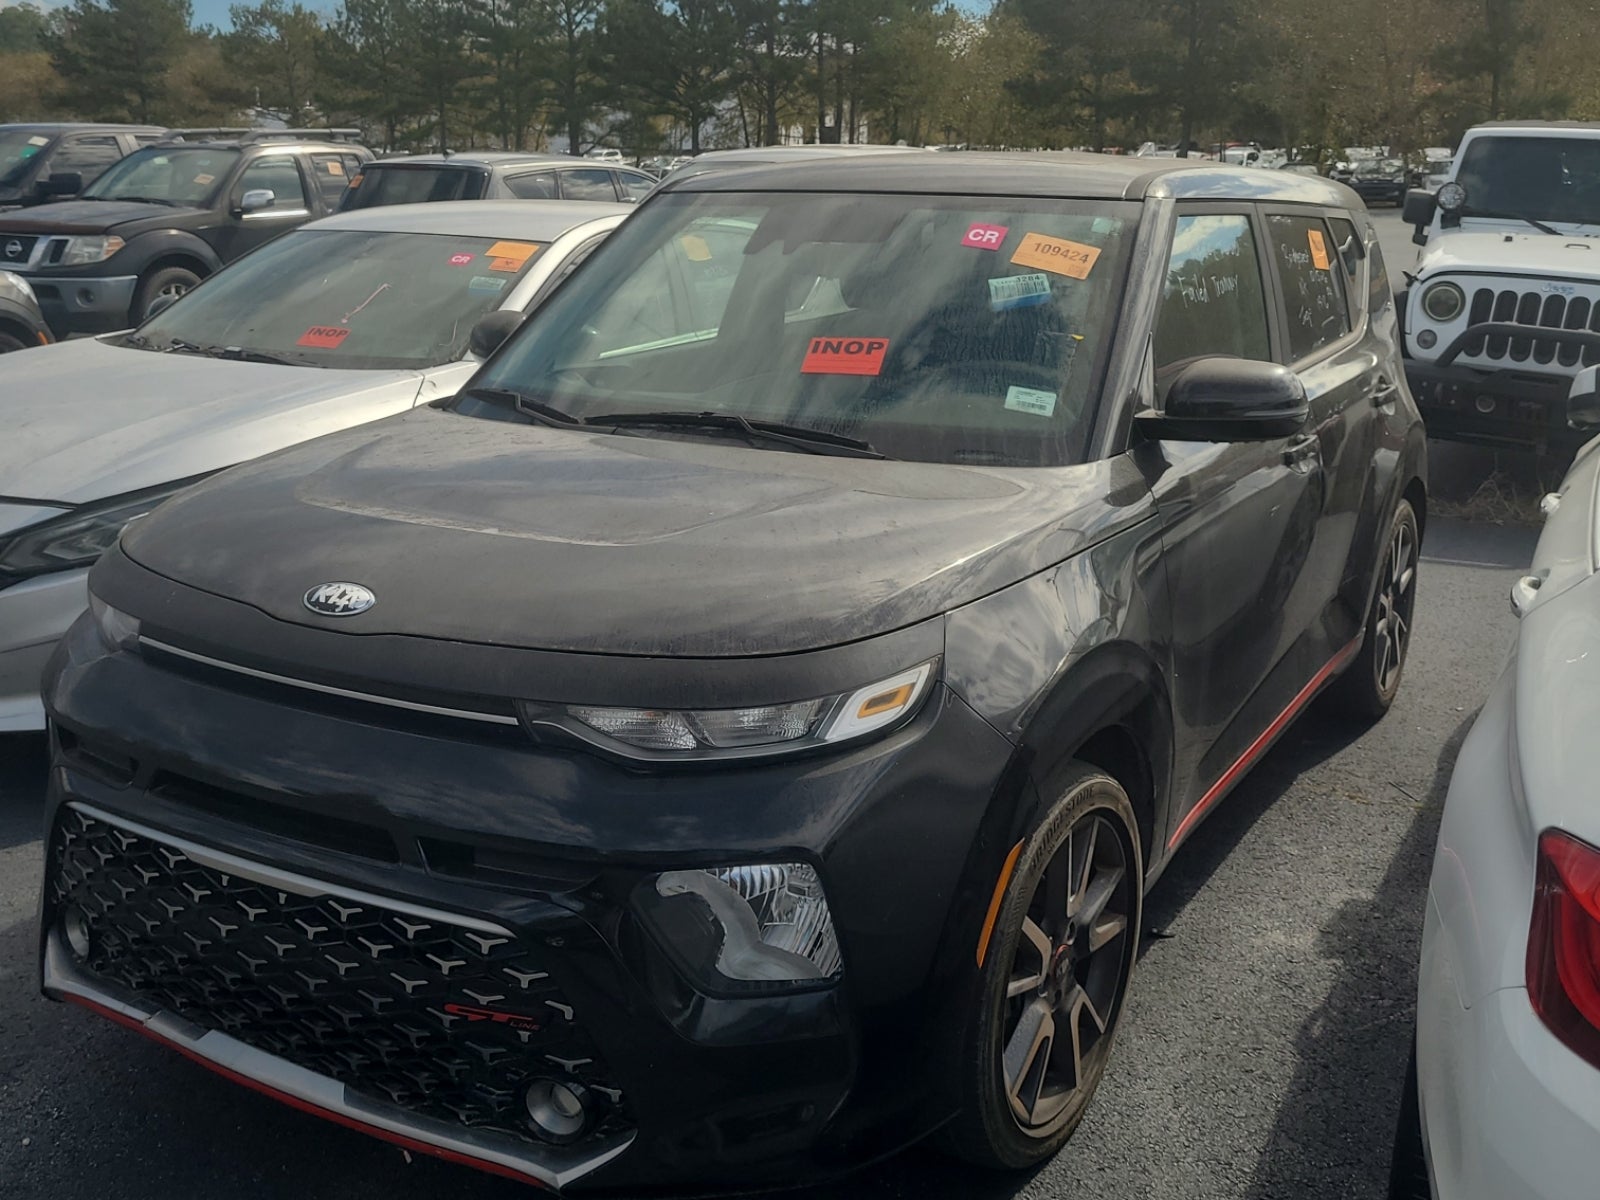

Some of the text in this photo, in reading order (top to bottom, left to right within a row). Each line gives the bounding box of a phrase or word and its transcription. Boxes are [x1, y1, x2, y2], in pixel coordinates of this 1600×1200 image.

[967, 228, 1000, 244] CR
[451, 255, 471, 264] CR
[1033, 242, 1090, 264] 109424
[307, 327, 349, 338] INOP
[811, 340, 885, 355] INOP
